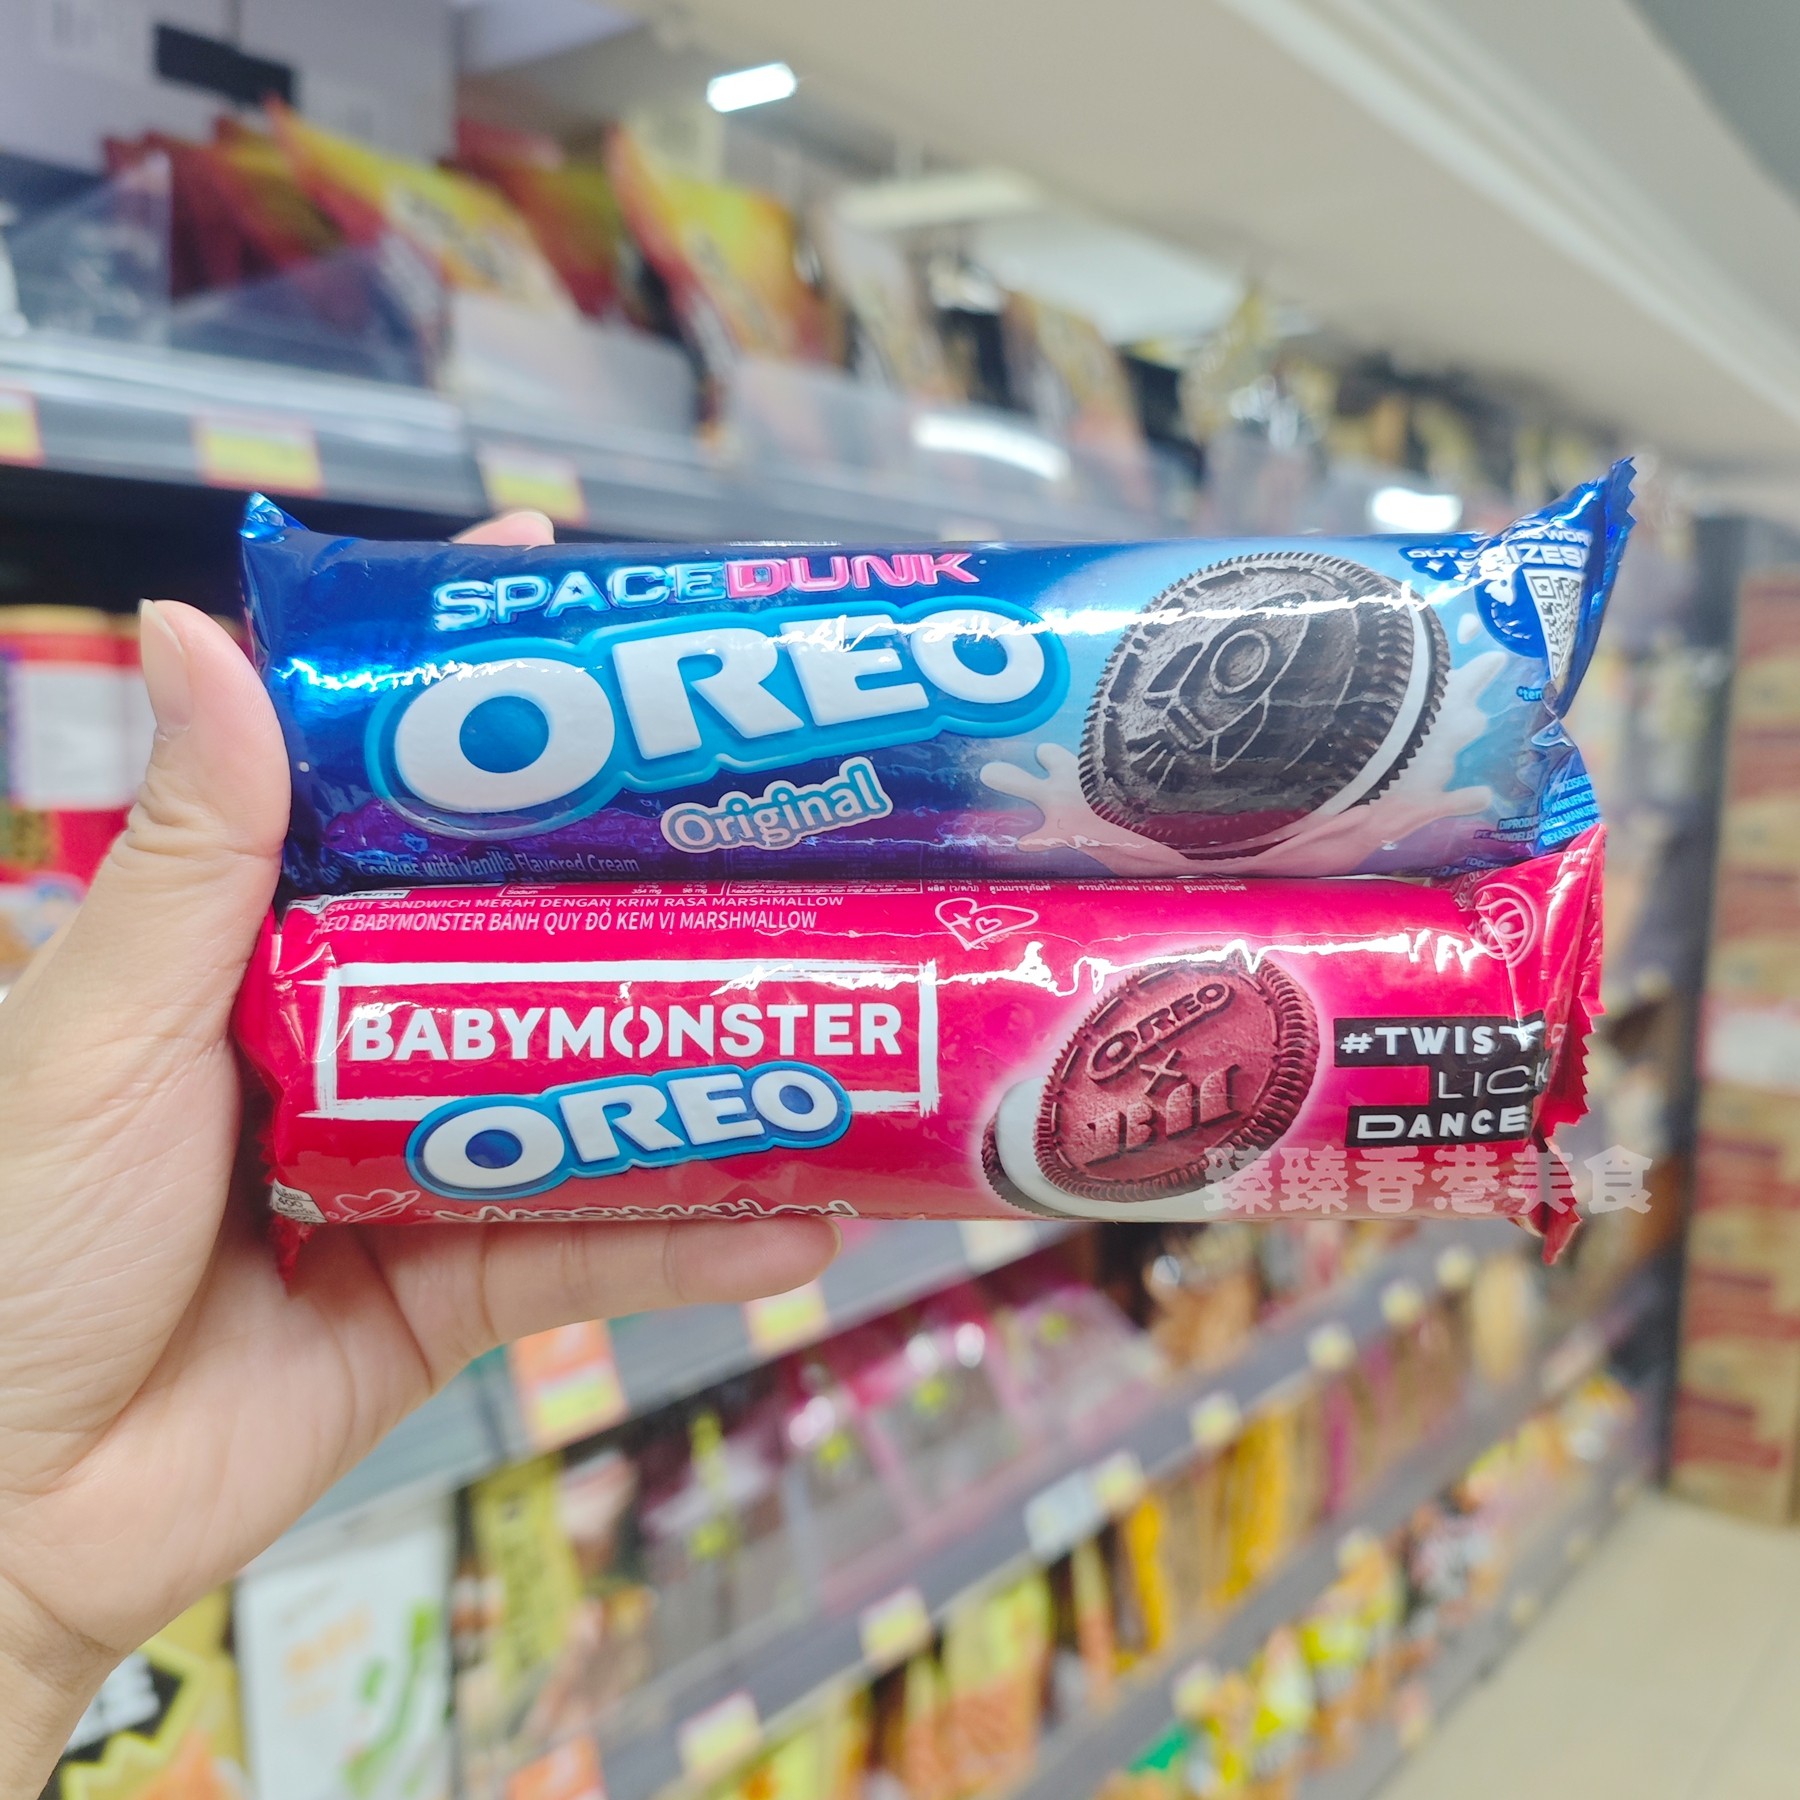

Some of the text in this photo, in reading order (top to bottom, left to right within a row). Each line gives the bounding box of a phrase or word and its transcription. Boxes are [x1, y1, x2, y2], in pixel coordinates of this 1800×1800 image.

[395, 607, 1047, 813] OREO
[671, 766, 883, 848] Original
[420, 853, 460, 877] with
[457, 850, 516, 877] Vanilla
[514, 852, 585, 873] Flavored
[587, 853, 640, 873] Cream
[352, 911, 485, 932] BABYMONSTER
[488, 909, 540, 931] BÁNH
[543, 911, 582, 935] QUY
[584, 907, 612, 931] ĐỎ
[616, 911, 655, 930] KEM
[658, 911, 675, 935] VỊ
[679, 910, 817, 930] MARSHMALLOW
[378, 899, 472, 910] SANDWICH
[474, 898, 536, 909] MERAH
[539, 898, 612, 908] DENGAN
[615, 897, 660, 908] KRIM
[663, 897, 708, 907] RASA
[711, 896, 844, 907] MARSHMALLOW
[351, 1001, 902, 1062] BABYMONSTER
[1085, 981, 1232, 1083] OREO
[1340, 1019, 1546, 1056] #TWIST
[1438, 1057, 1549, 1099] LICK
[422, 1070, 837, 1191] OREO
[1356, 1104, 1530, 1140] DANCE
